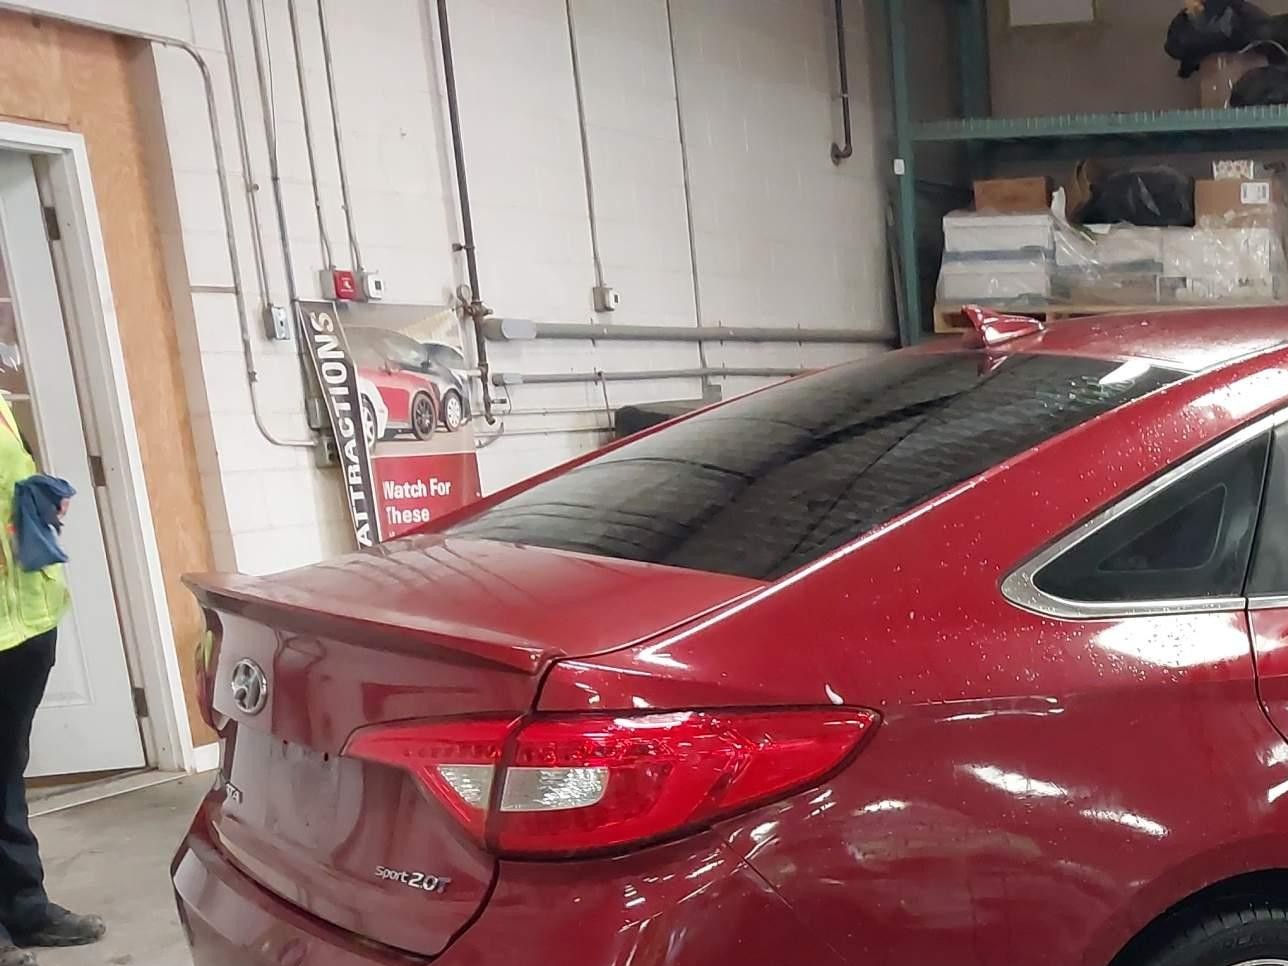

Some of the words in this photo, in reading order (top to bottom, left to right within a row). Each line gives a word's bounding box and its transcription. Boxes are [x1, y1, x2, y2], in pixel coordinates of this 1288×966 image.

[308, 311, 374, 547] ATTRACTIONS
[430, 478, 451, 496] For
[386, 506, 430, 524] These
[375, 865, 408, 883] Sport
